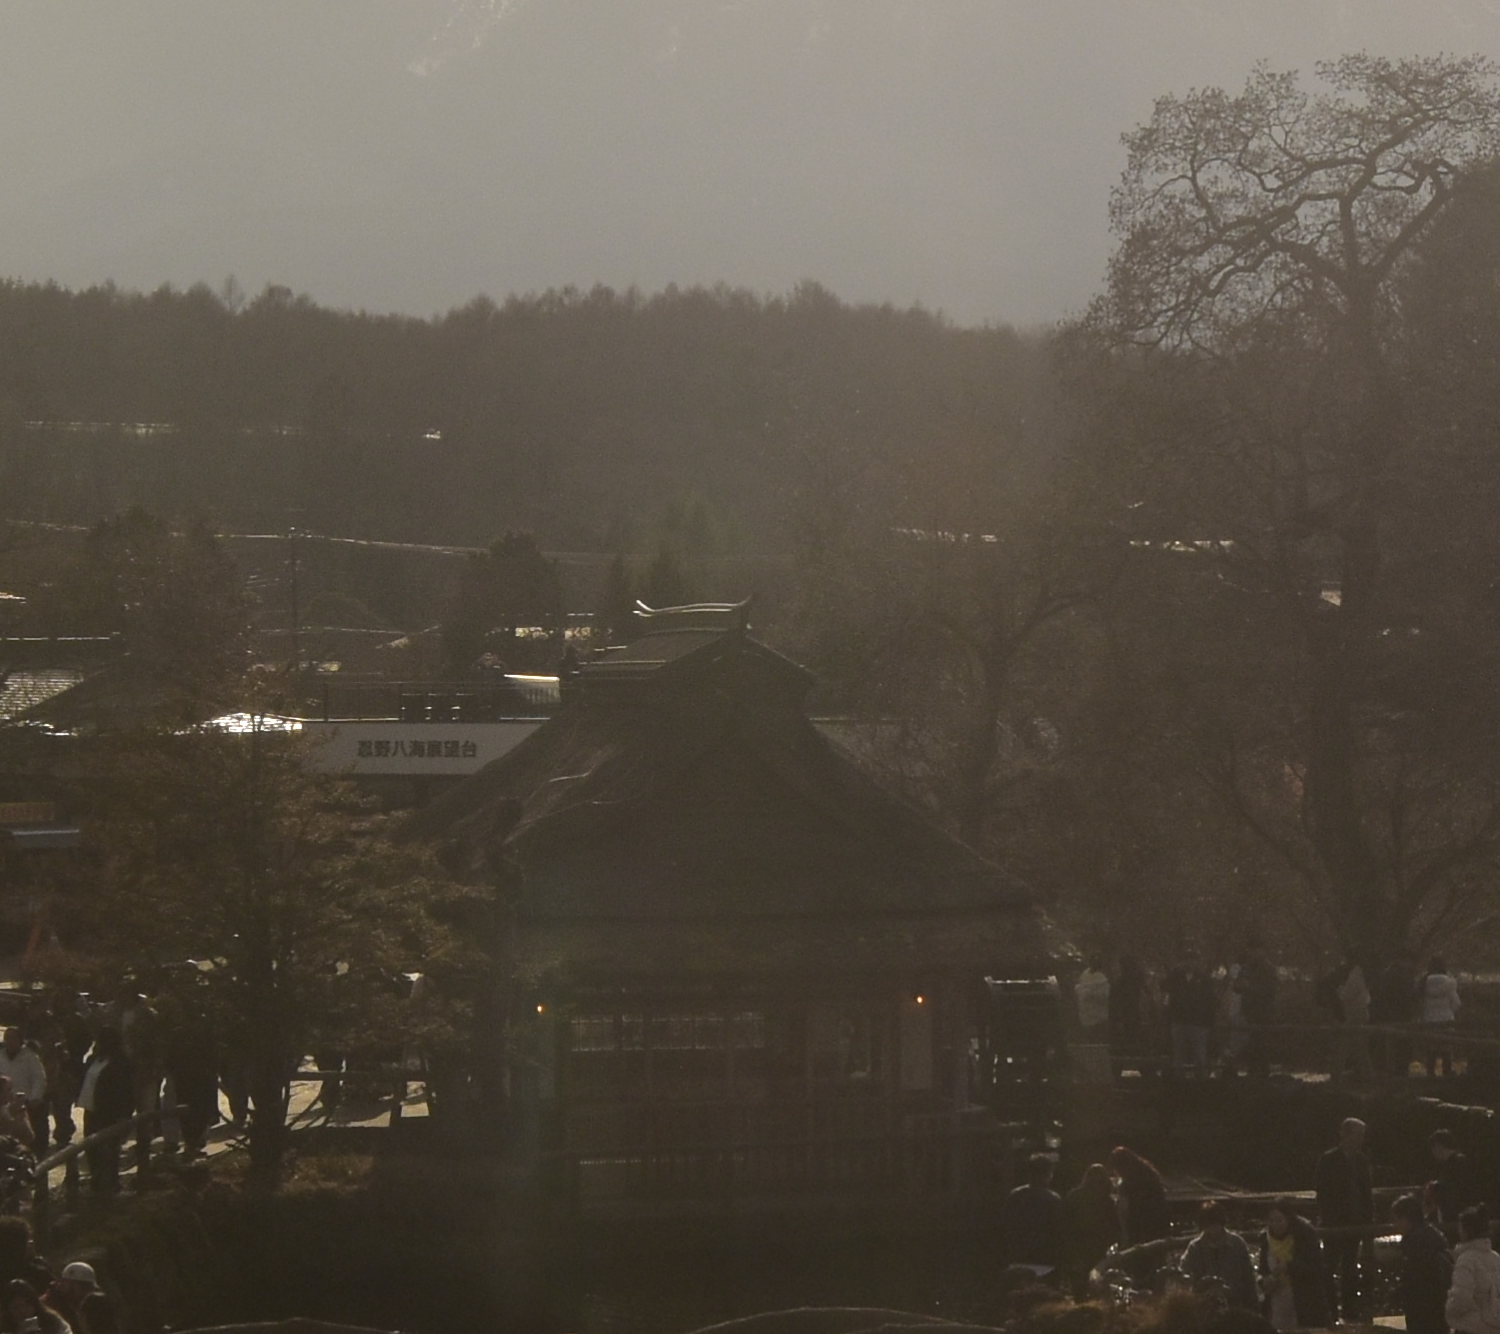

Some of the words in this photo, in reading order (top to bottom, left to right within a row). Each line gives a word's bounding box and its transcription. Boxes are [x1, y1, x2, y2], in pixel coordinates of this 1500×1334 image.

[357, 740, 477, 758] 忍野八海展望台
